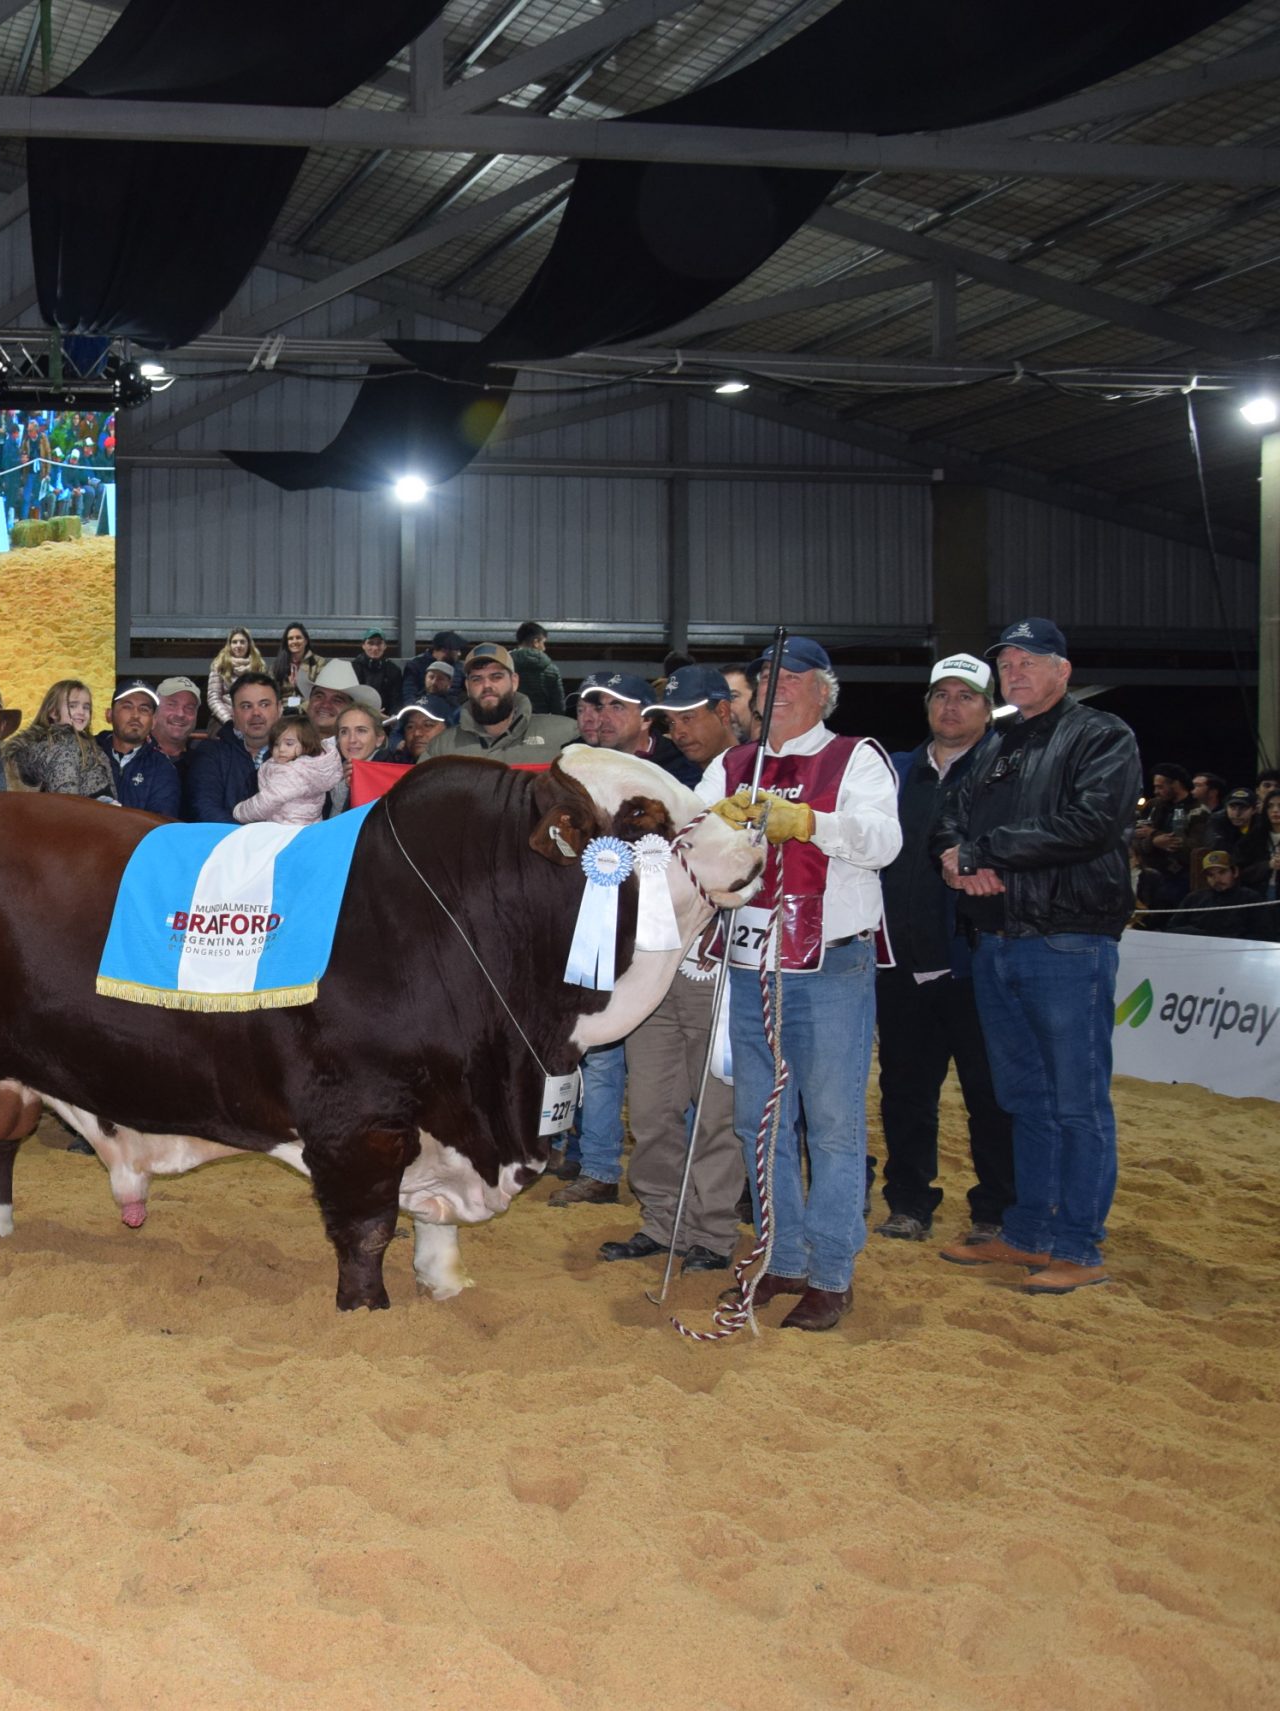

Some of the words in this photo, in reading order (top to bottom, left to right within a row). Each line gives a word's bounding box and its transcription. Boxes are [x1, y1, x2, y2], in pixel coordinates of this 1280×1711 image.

[195, 902, 269, 913] MUNDIALMENTE
[172, 911, 281, 935] BRAFORD
[170, 933, 245, 946] ARGENTINA
[731, 925, 766, 950] 27
[1160, 986, 1280, 1047] agripay
[551, 1100, 571, 1121] 227
